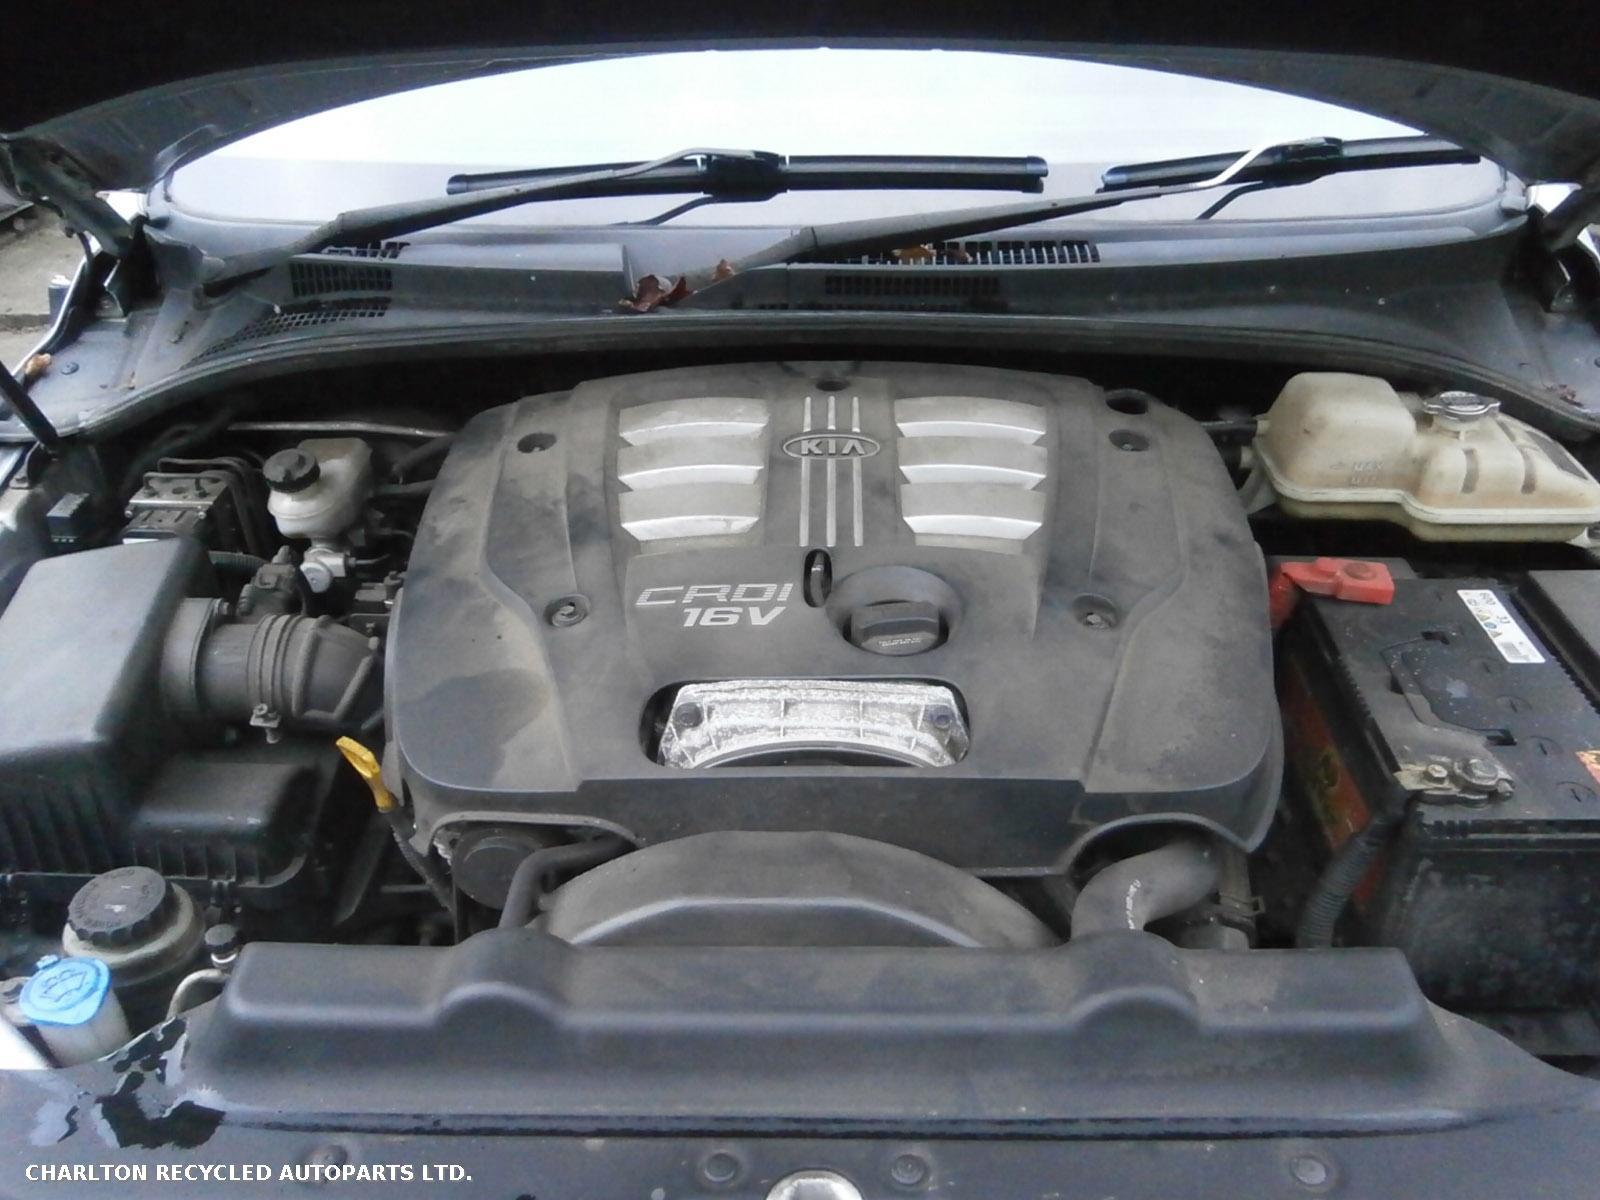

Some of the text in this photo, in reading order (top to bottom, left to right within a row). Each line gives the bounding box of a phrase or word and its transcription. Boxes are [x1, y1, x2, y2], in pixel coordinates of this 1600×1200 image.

[800, 439, 866, 456] KIA
[635, 582, 794, 606] CRDI
[683, 606, 787, 627] 16V
